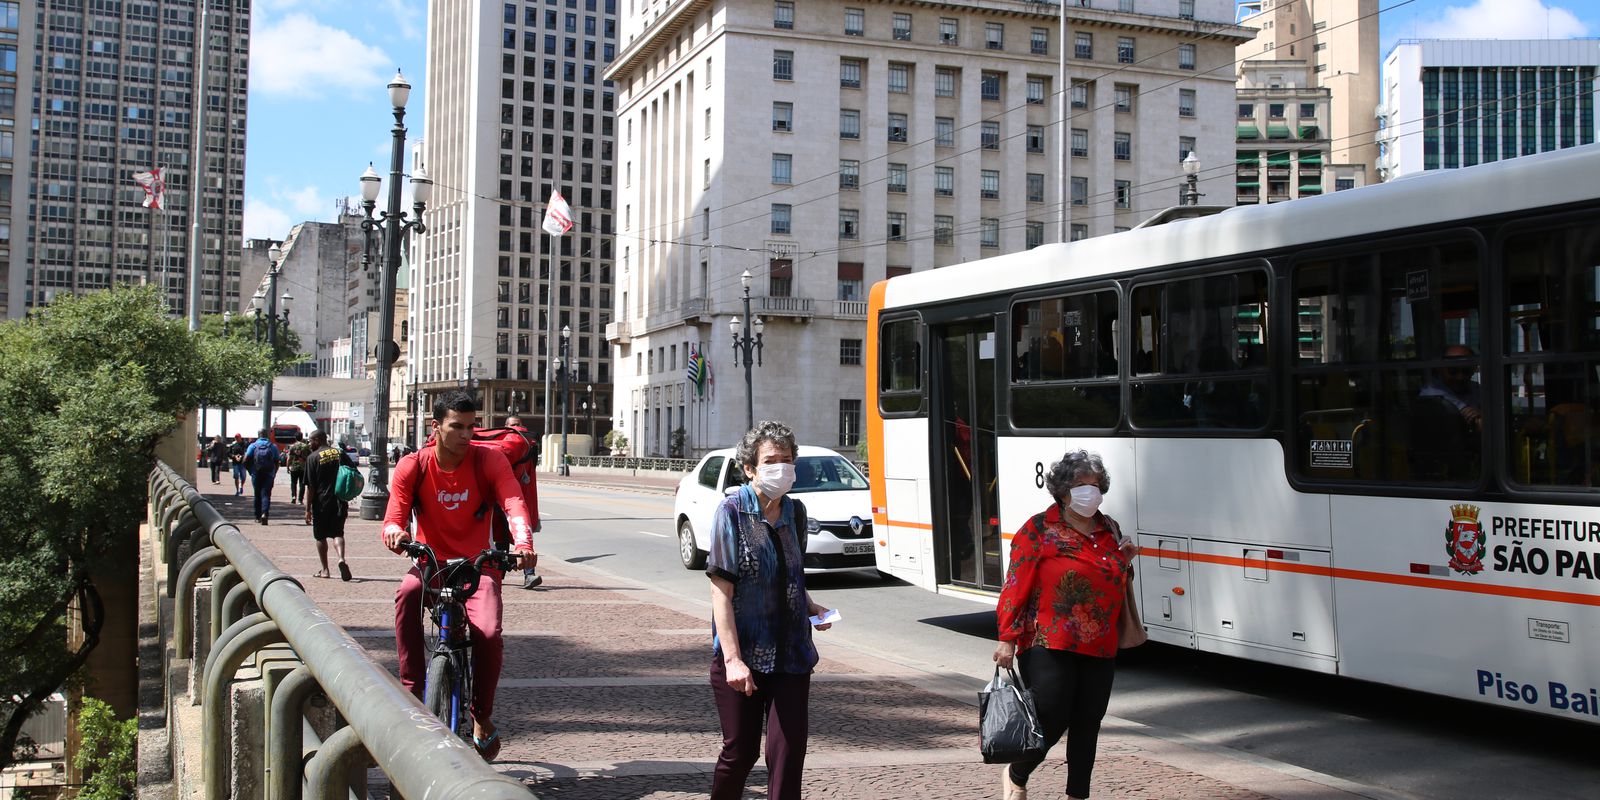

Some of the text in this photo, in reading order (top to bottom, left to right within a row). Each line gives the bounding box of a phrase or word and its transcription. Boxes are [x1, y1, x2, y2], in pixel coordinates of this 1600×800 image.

[1035, 461, 1045, 489] 8
[437, 489, 469, 504] ifood
[1492, 516, 1600, 542] PREFEITUR
[1493, 540, 1550, 576] SÃO
[1476, 669, 1539, 705] Piso
